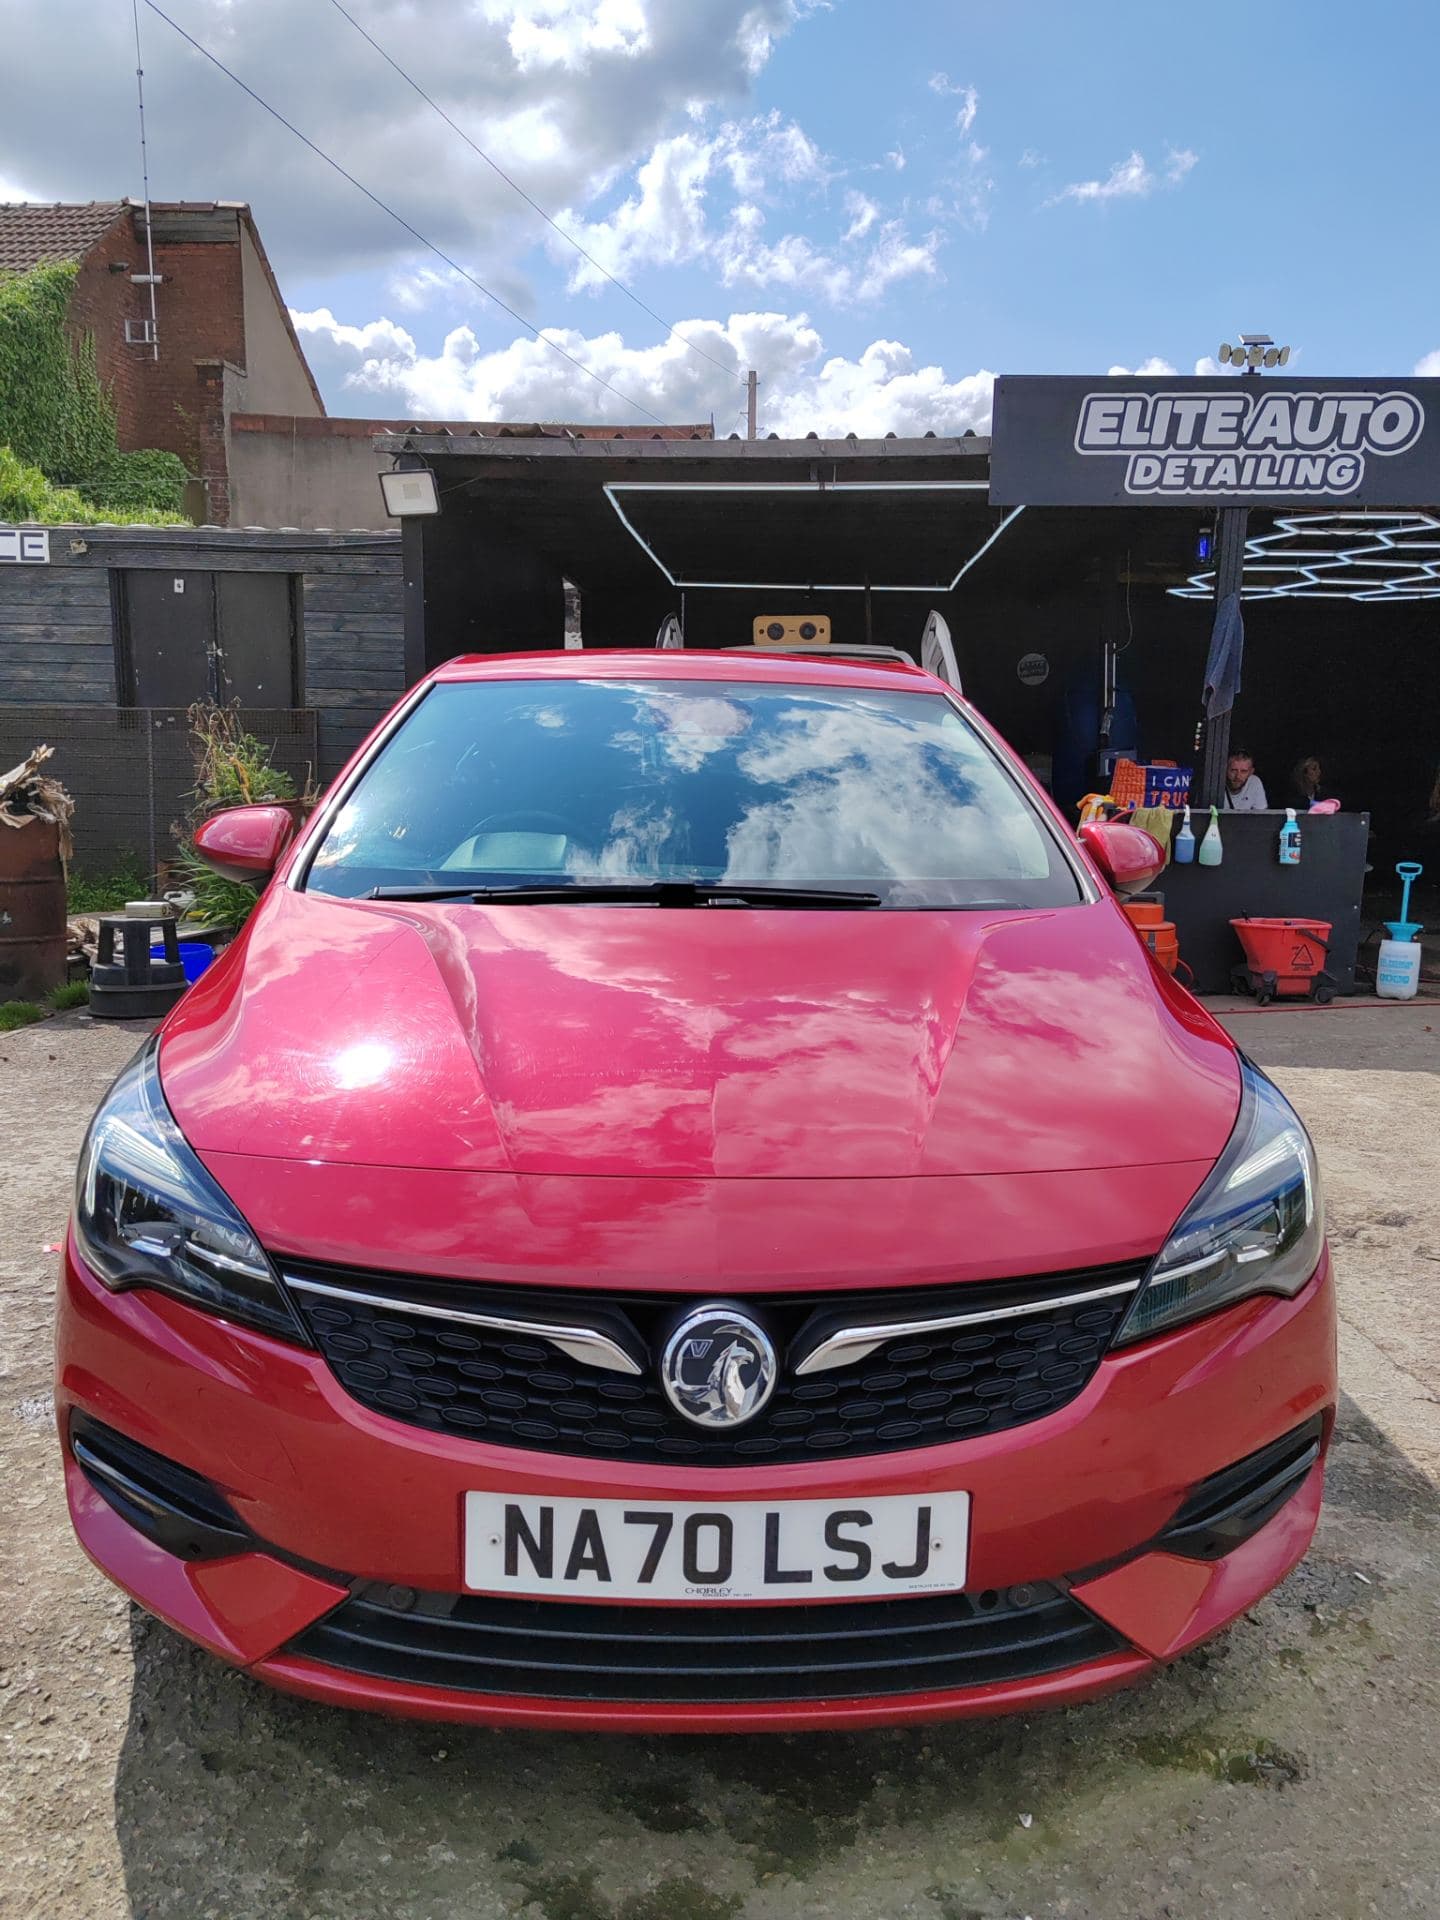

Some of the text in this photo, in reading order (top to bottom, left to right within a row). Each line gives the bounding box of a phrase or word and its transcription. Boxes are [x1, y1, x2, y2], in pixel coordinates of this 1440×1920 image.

[1083, 397, 1413, 446] ELITE AUTO
[1132, 455, 1356, 486] DETAILING
[1152, 775, 1156, 786] I
[504, 1503, 931, 1585] NA70 LSJ
